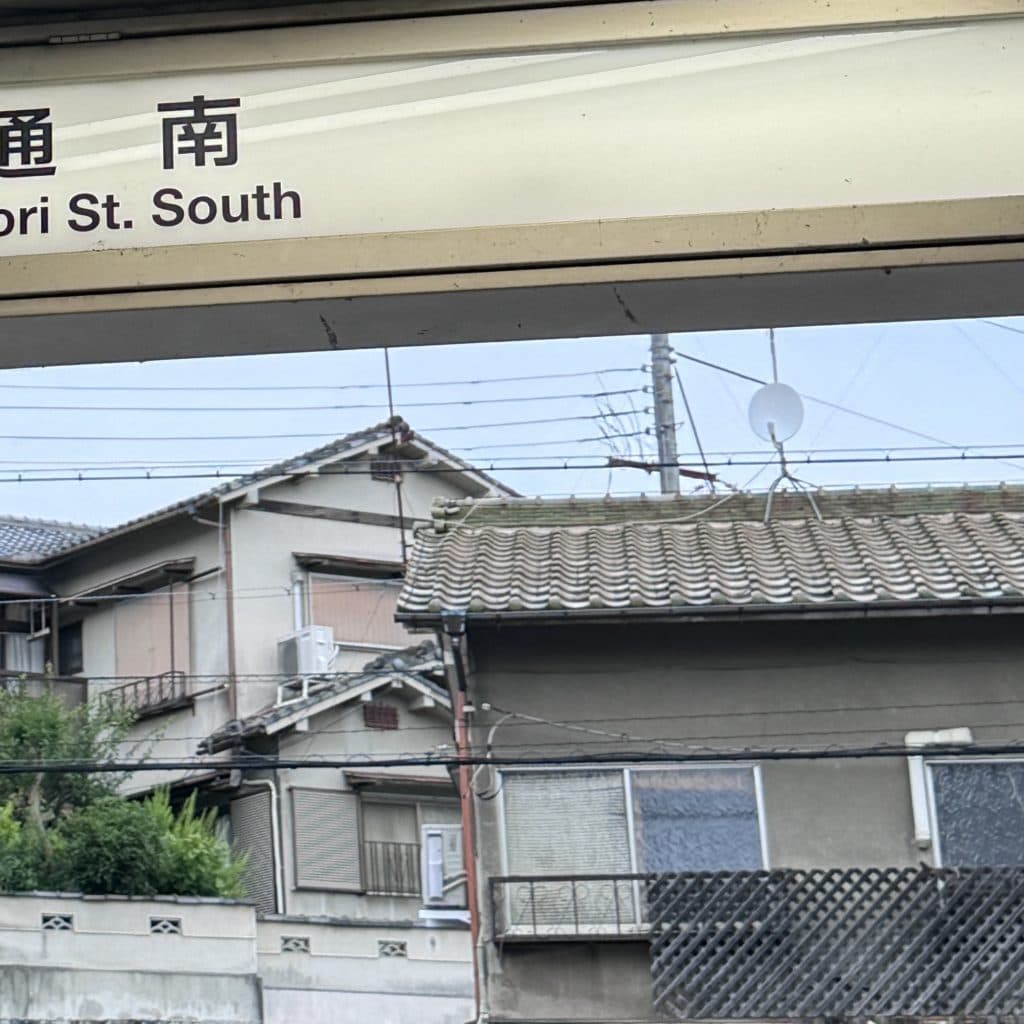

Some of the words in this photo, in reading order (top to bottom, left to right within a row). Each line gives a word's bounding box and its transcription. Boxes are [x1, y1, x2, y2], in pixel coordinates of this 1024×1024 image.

[157, 95, 241, 170] 南
[67, 193, 133, 232] St.
[151, 182, 301, 227] South
